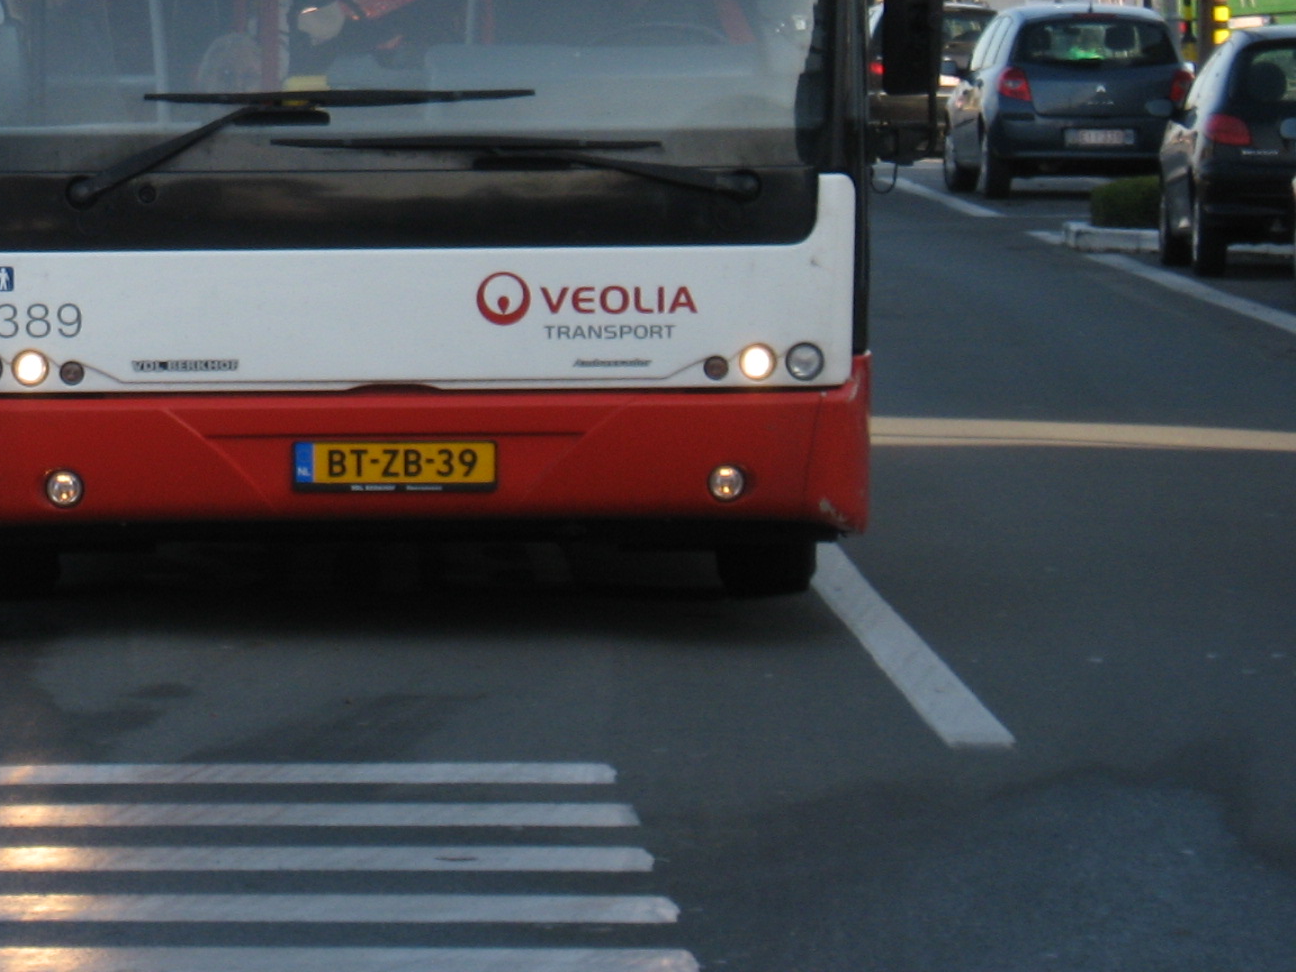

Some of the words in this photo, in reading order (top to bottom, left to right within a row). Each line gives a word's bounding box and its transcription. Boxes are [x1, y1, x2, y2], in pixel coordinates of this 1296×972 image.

[540, 285, 698, 315] VEOLIA
[545, 325, 677, 340] TRANSPORT
[131, 359, 164, 372] VDL
[169, 359, 239, 372] BERKHOF
[327, 448, 479, 478] BT-ZB-39
